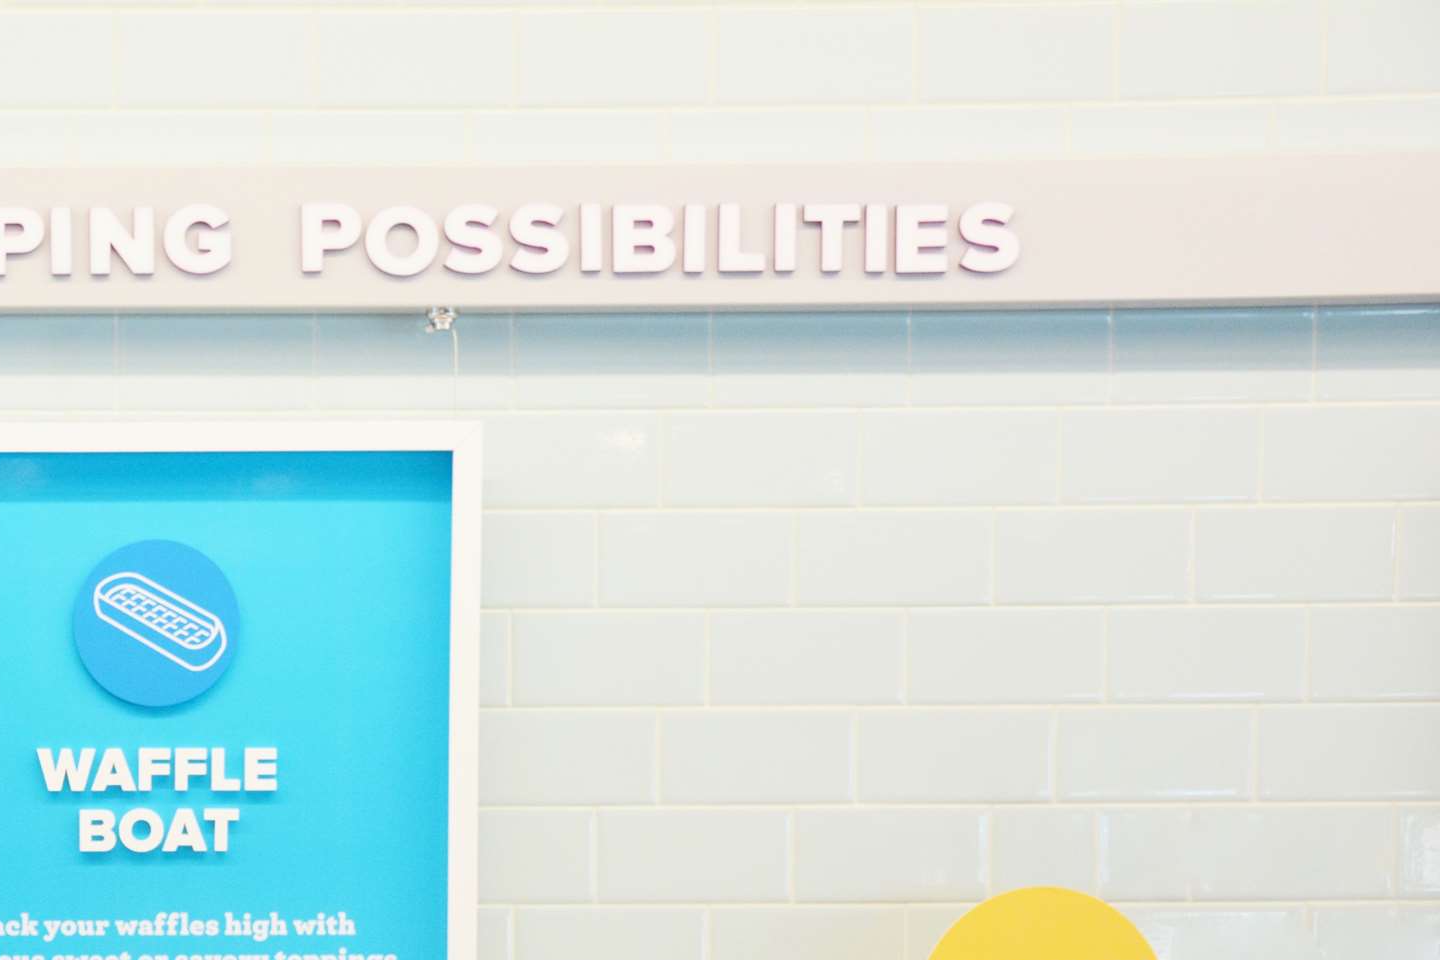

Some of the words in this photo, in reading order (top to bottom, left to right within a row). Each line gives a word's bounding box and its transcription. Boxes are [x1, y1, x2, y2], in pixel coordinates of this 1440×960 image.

[301, 201, 1021, 278] POSSIBILITIES
[36, 747, 278, 792] WAFFLE
[78, 808, 240, 853] BOAT
[43, 918, 109, 942] your
[115, 912, 219, 937] waffles
[224, 912, 288, 942] high
[293, 912, 356, 937] with
